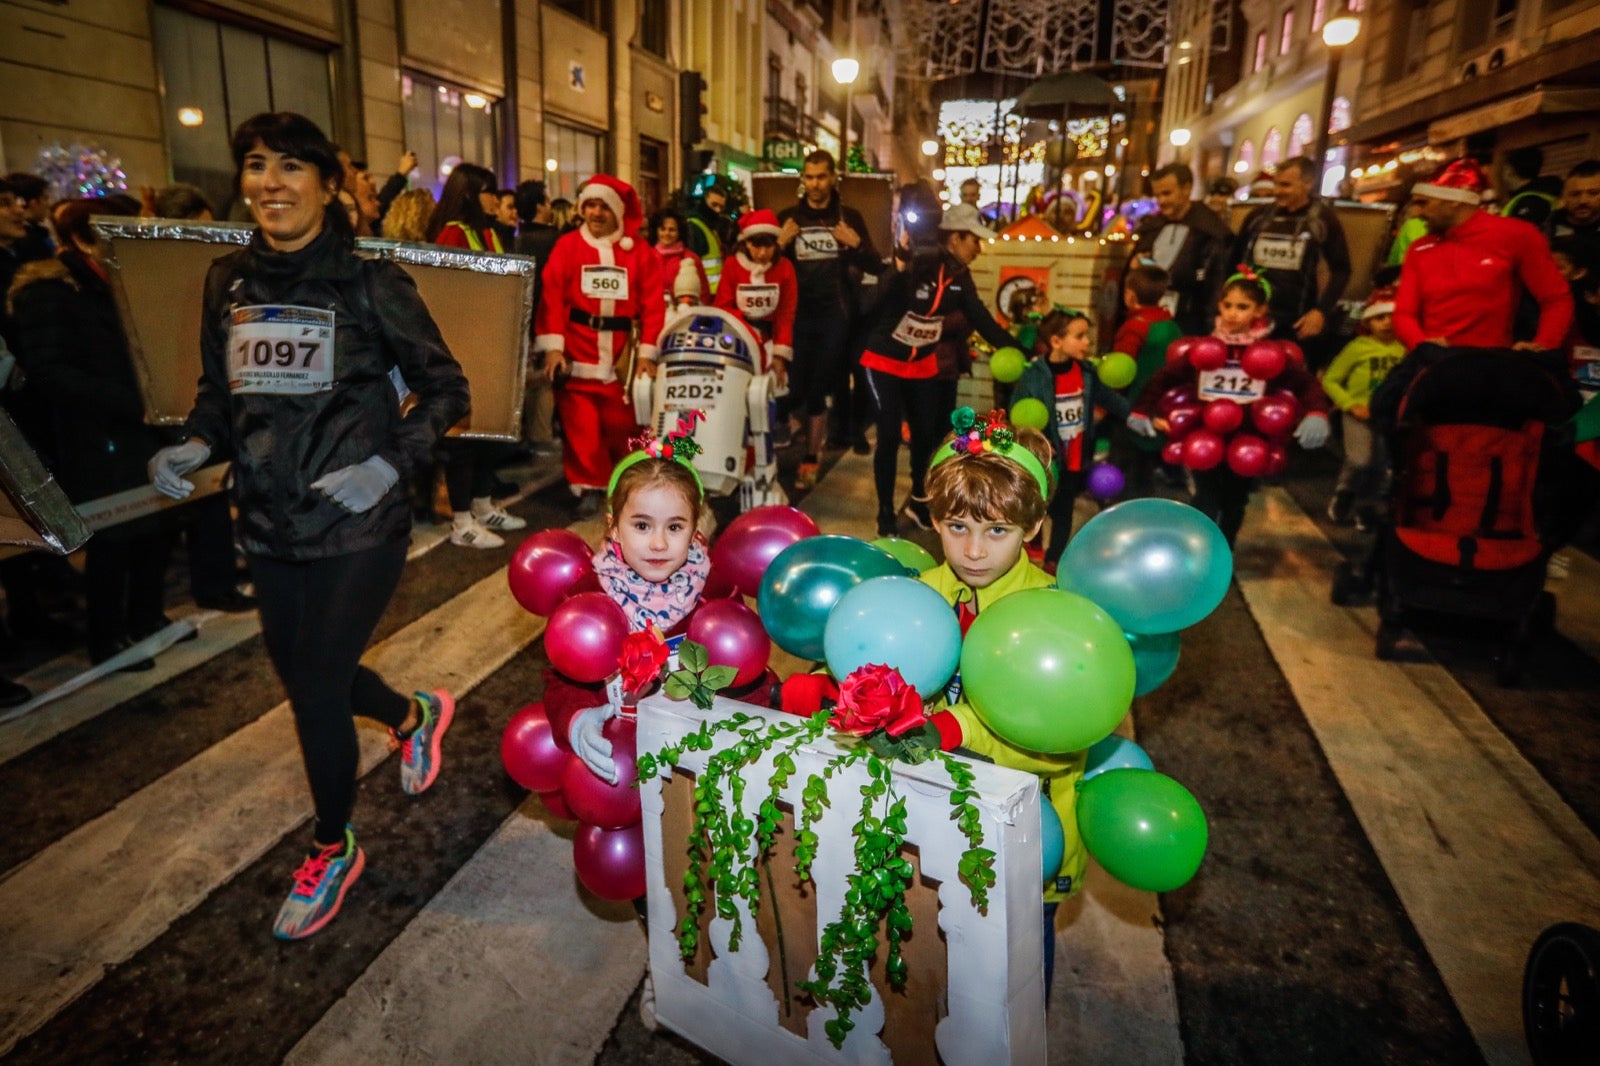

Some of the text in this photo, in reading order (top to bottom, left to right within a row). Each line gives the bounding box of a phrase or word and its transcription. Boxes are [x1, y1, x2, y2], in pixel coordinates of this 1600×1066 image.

[767, 143, 798, 158] 16H
[592, 278, 619, 290] 560
[746, 296, 771, 308] 561
[237, 340, 320, 368] 1097
[1214, 375, 1253, 391] 212
[666, 384, 714, 400] R2D2
